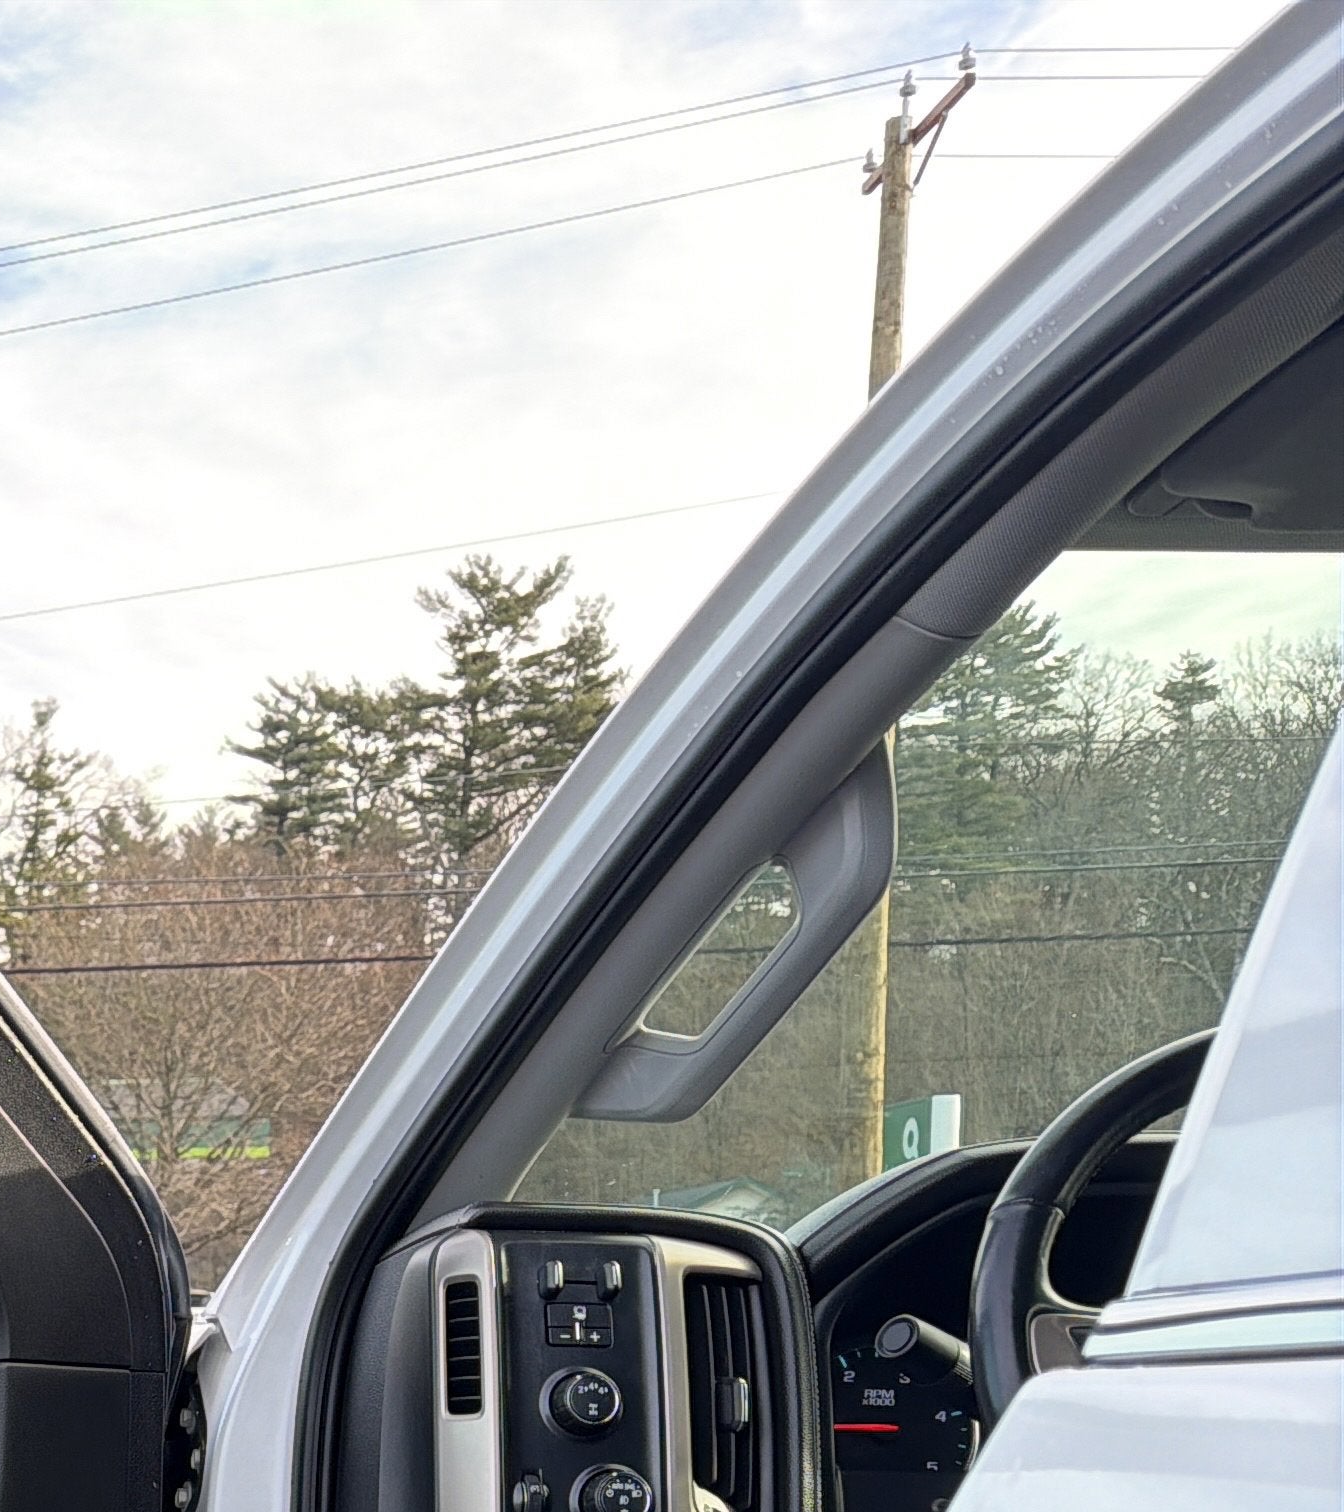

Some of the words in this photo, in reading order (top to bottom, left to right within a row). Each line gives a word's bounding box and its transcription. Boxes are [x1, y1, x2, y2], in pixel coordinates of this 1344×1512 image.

[843, 1371, 856, 1382] 2
[863, 1389, 895, 1398] RPM
[934, 1410, 947, 1422] 4
